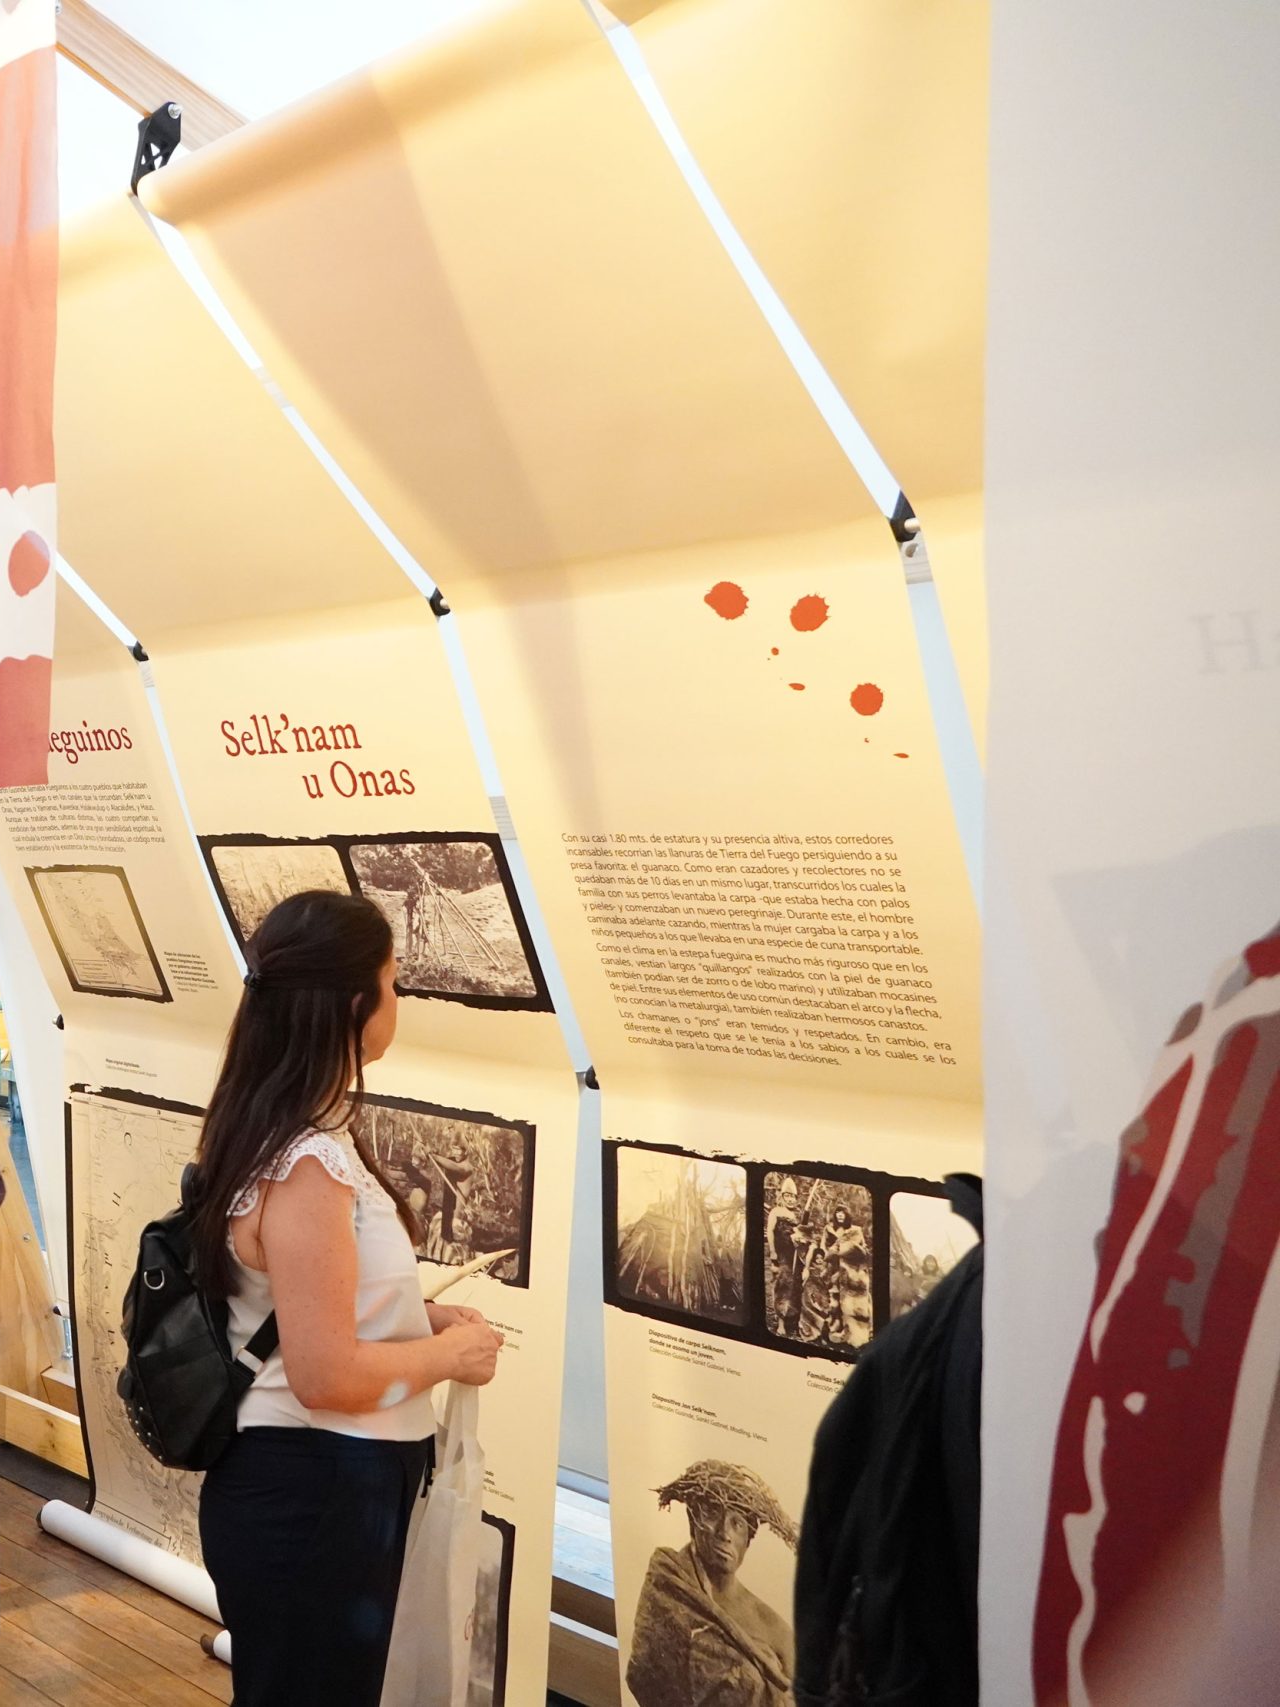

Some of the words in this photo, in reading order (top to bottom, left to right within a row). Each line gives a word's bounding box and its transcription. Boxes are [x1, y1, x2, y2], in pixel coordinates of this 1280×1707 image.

[48, 720, 133, 764] eguinos
[220, 714, 362, 758] Selk'nam
[303, 774, 324, 799] u
[331, 761, 416, 799] Onas
[561, 833, 579, 843] Con
[580, 835, 591, 843] su
[591, 833, 608, 843] casi
[649, 833, 662, 844] de
[663, 835, 701, 844] estatura
[702, 836, 708, 846] y
[710, 836, 722, 844] su
[723, 834, 771, 846] presencia
[772, 834, 803, 845] altiva,
[805, 835, 833, 845] estos
[835, 834, 894, 845] corredores
[570, 862, 593, 871] presa
[630, 862, 639, 871] el
[641, 864, 682, 874] guanaco.
[684, 862, 713, 873] Como
[715, 865, 737, 874] eran
[739, 864, 790, 875] cazadores
[792, 867, 799, 877] y
[802, 865, 867, 876] recolectores
[870, 868, 886, 877] no
[889, 868, 902, 877] se
[574, 874, 617, 885] quedaban
[617, 875, 636, 885] más
[636, 876, 649, 886] de
[650, 876, 661, 886] 10
[682, 879, 695, 887] en
[696, 879, 709, 887] un
[710, 880, 743, 888] mismo
[772, 880, 840, 891] transcurridos
[840, 880, 858, 891] los
[859, 881, 894, 892] cuales
[894, 882, 906, 893] la
[582, 903, 587, 911] y
[617, 904, 623, 913] y
[624, 904, 681, 914] comenzaban
[682, 907, 695, 915] un
[696, 907, 726, 916] nuevo
[727, 908, 786, 921] peregrinaje.
[786, 909, 829, 921] Durante
[830, 912, 856, 923] este,
[857, 912, 868, 922] el
[869, 912, 914, 925] hombre
[587, 915, 628, 925] caminaba
[629, 916, 666, 927] adelante
[709, 921, 751, 931] mientras
[751, 921, 762, 932] la
[763, 923, 792, 935] mujer
[794, 925, 836, 937] cargaba
[837, 925, 848, 936] la
[850, 929, 881, 939] carpa
[882, 930, 889, 941] y
[893, 931, 900, 939] a
[901, 929, 919, 940] los
[591, 927, 615, 937] niños
[614, 929, 658, 940] pequeños
[664, 931, 679, 941] los
[679, 934, 697, 943] que
[697, 932, 732, 944] llevaba
[733, 936, 746, 944] en
[746, 938, 766, 946] una
[766, 938, 803, 949] especie
[805, 938, 819, 949] de
[820, 942, 846, 951] cuna
[846, 942, 924, 955] transportable.
[618, 1009, 634, 1019] Los
[637, 1011, 681, 1024] chamanes
[684, 1017, 691, 1025] o
[725, 1020, 747, 1029] eran
[750, 1022, 790, 1034] temidos
[793, 1028, 799, 1037] y
[804, 1029, 862, 1042] respetados.
[866, 1033, 881, 1043] En
[933, 1042, 952, 1051] era
[628, 1036, 674, 1048] consultaba
[674, 1041, 695, 1050] para
[695, 1041, 705, 1051] la
[705, 1043, 731, 1053] toma
[732, 1045, 744, 1055] de
[745, 1047, 773, 1058] todas
[772, 1049, 787, 1060] las
[788, 1051, 842, 1066] decisiones.
